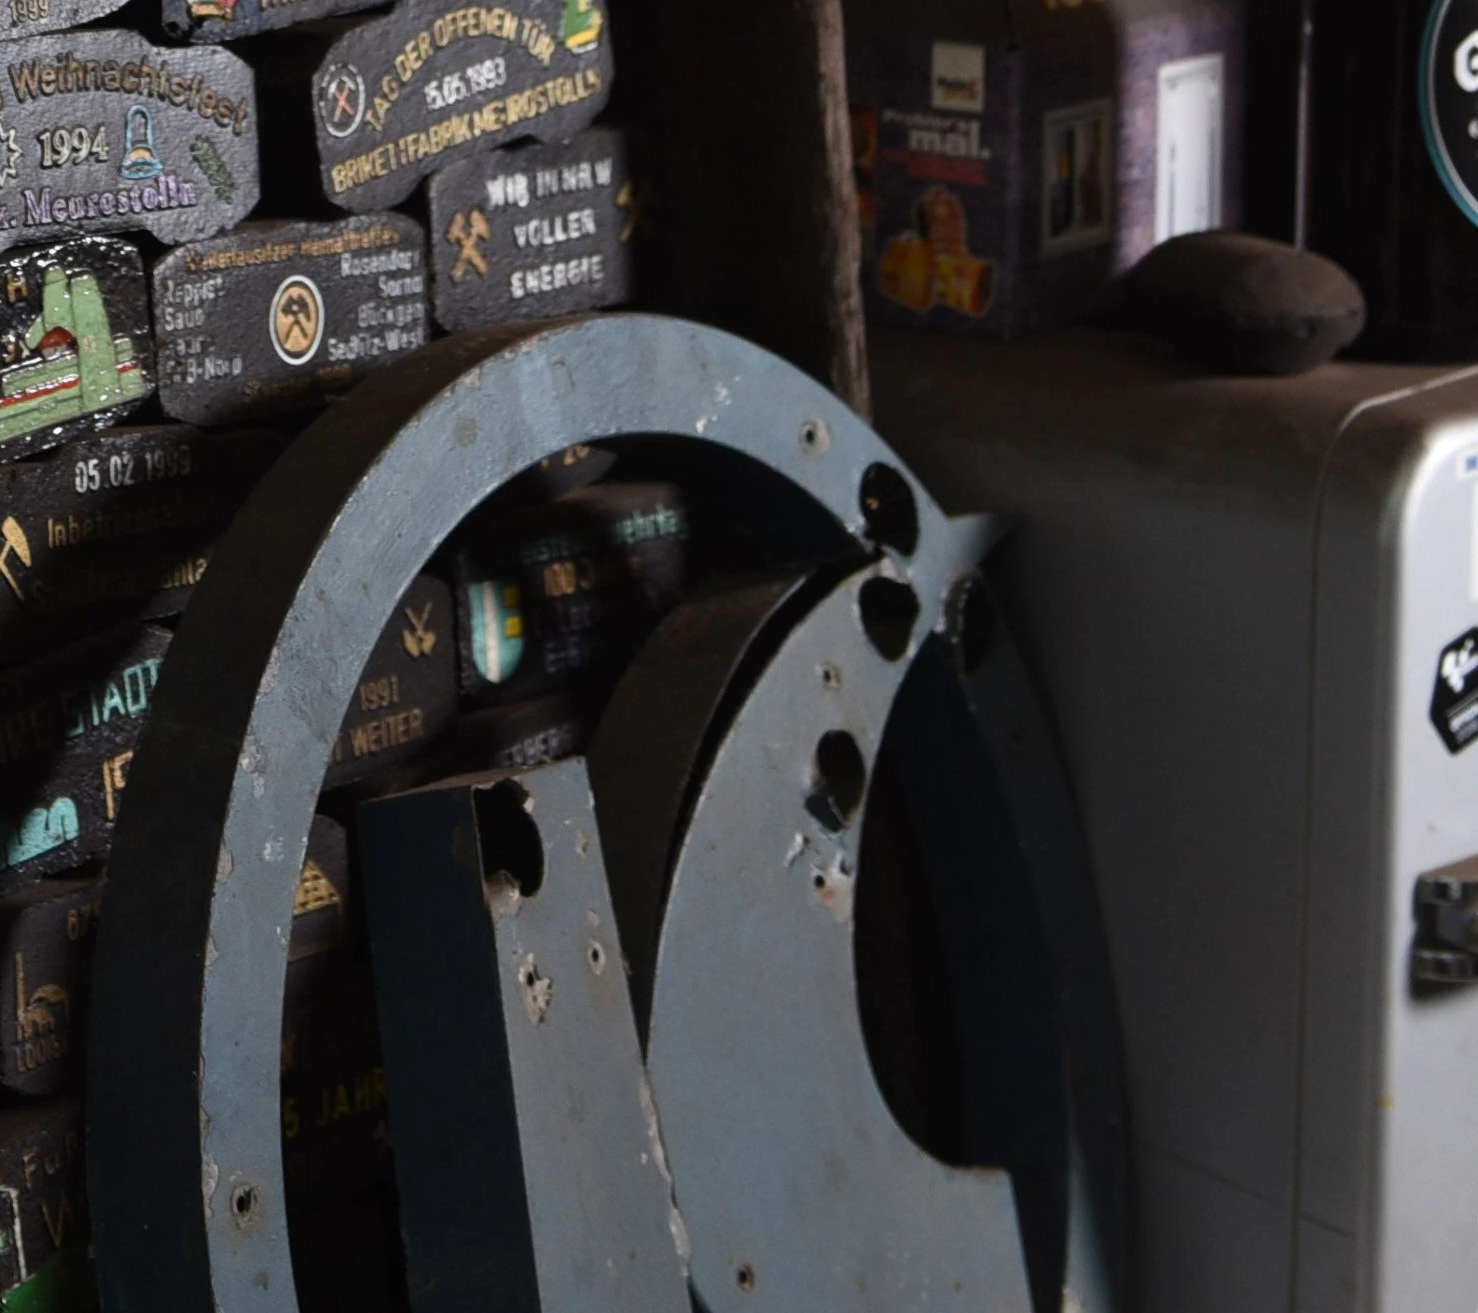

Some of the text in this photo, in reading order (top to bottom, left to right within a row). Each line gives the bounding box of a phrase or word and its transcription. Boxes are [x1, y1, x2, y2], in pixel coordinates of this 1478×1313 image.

[9, 50, 251, 137] Weihnachtsfest
[365, 75, 400, 132] TAG
[395, 31, 434, 80] DER
[434, 6, 519, 47] OFFENEN
[37, 125, 111, 170] 1994
[514, 208, 596, 248] VOLLER
